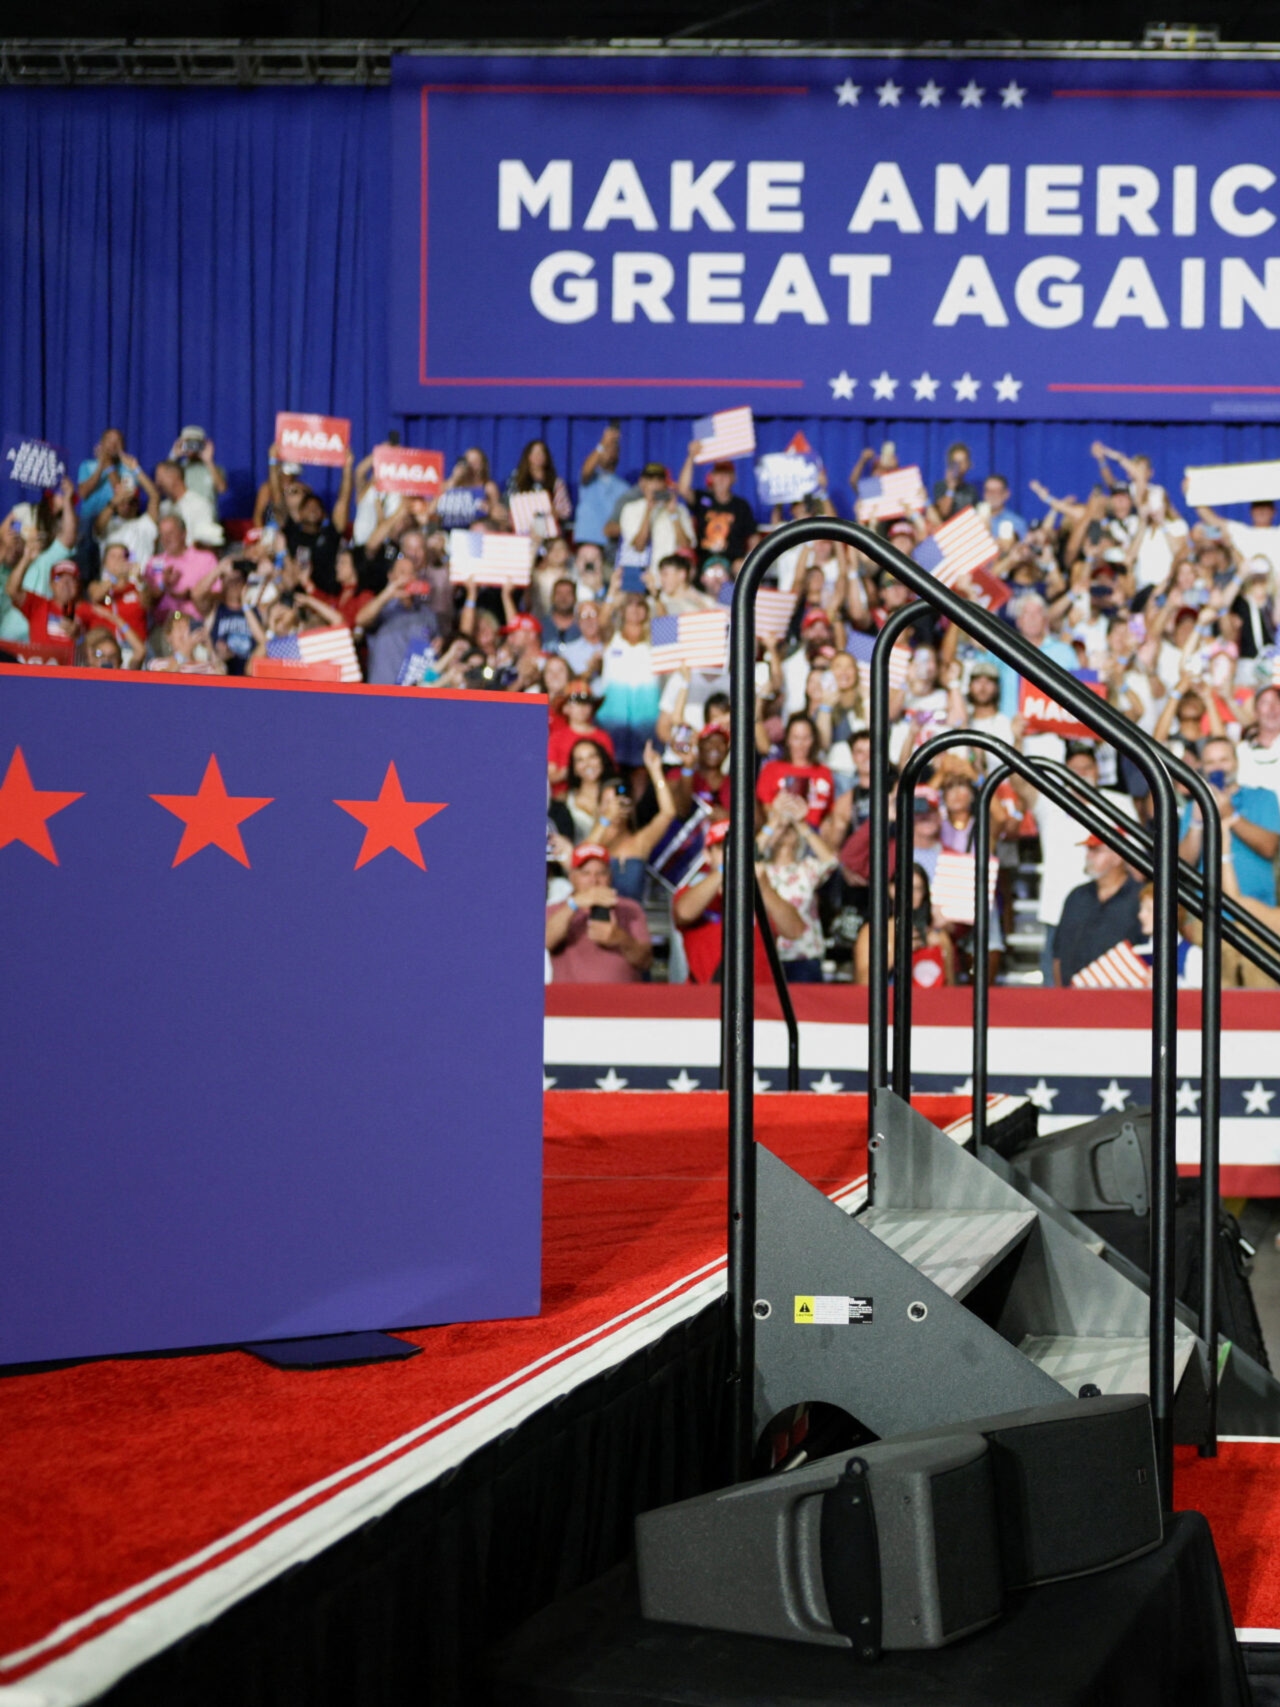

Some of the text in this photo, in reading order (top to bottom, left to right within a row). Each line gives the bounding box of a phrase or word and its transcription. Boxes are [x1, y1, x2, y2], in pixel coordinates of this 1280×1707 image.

[498, 159, 805, 233] MAKE
[530, 250, 892, 326] GREAT
[281, 429, 344, 452] MAGA
[379, 462, 439, 483] MAGA
